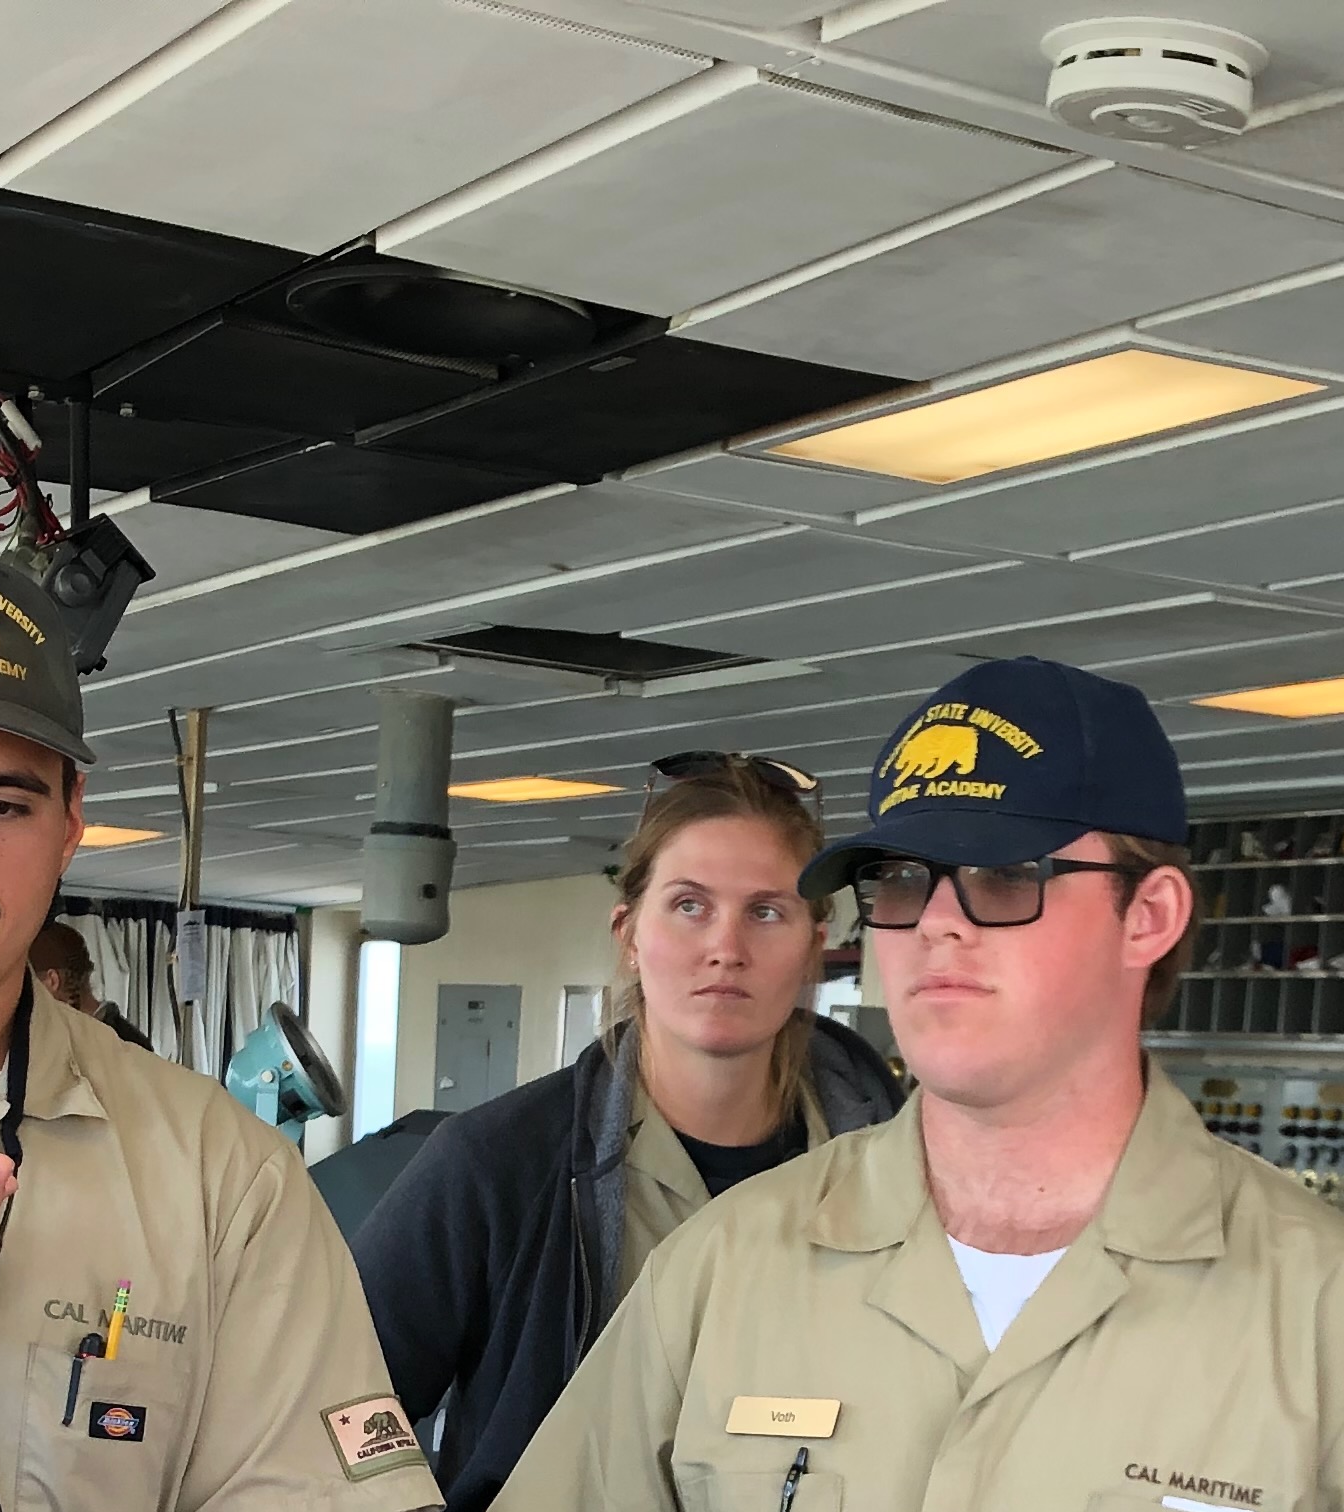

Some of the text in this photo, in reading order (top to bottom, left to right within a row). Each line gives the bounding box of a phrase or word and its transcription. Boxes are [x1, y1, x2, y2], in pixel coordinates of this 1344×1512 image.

[925, 703, 968, 722] STATE
[968, 707, 1044, 759] UNIVERSITY
[924, 781, 1008, 800] ACADEMY
[44, 1300, 89, 1324] CAL
[771, 1410, 796, 1423] Voth
[1125, 1463, 1263, 1506] CAL MARITIME
